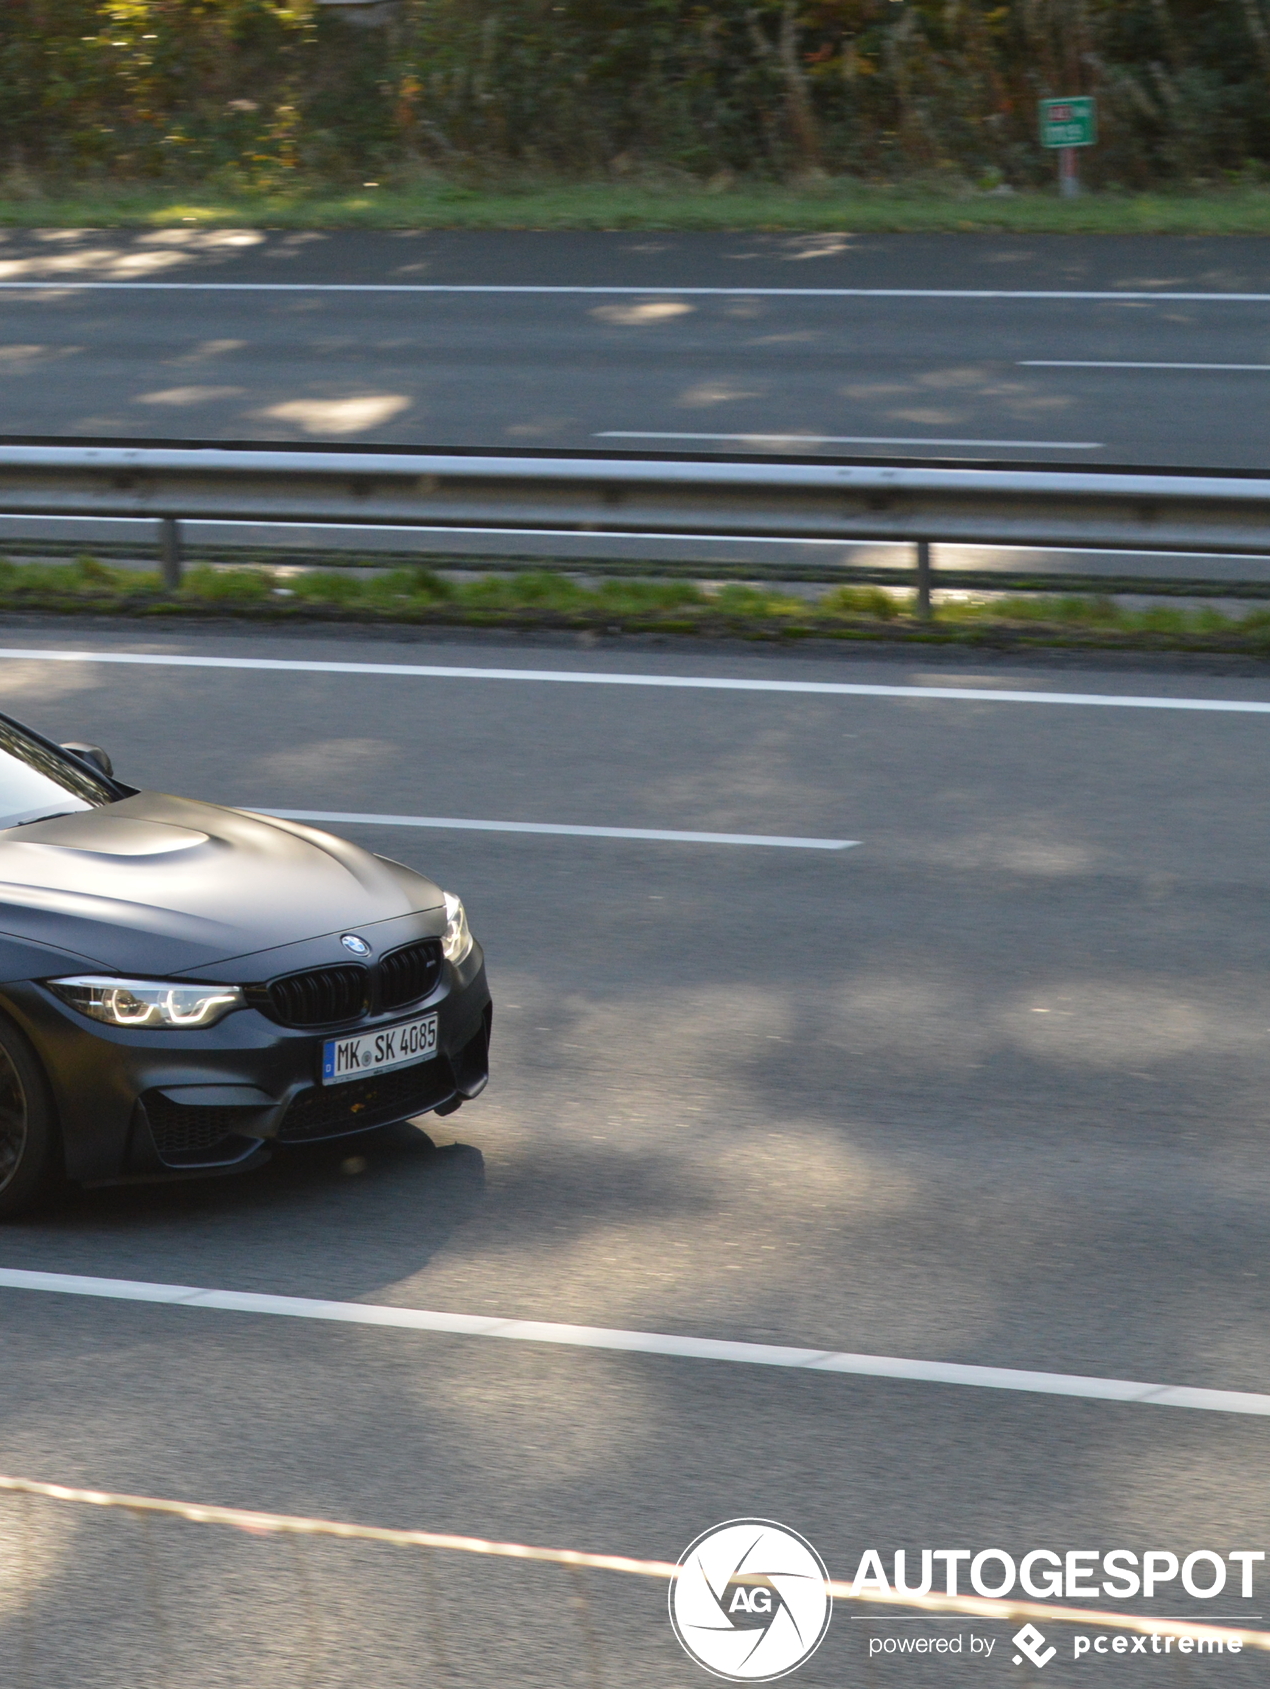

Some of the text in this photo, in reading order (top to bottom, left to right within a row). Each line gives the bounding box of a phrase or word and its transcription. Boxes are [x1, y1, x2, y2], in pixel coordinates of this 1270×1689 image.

[337, 1020, 436, 1072] MK SK 4085
